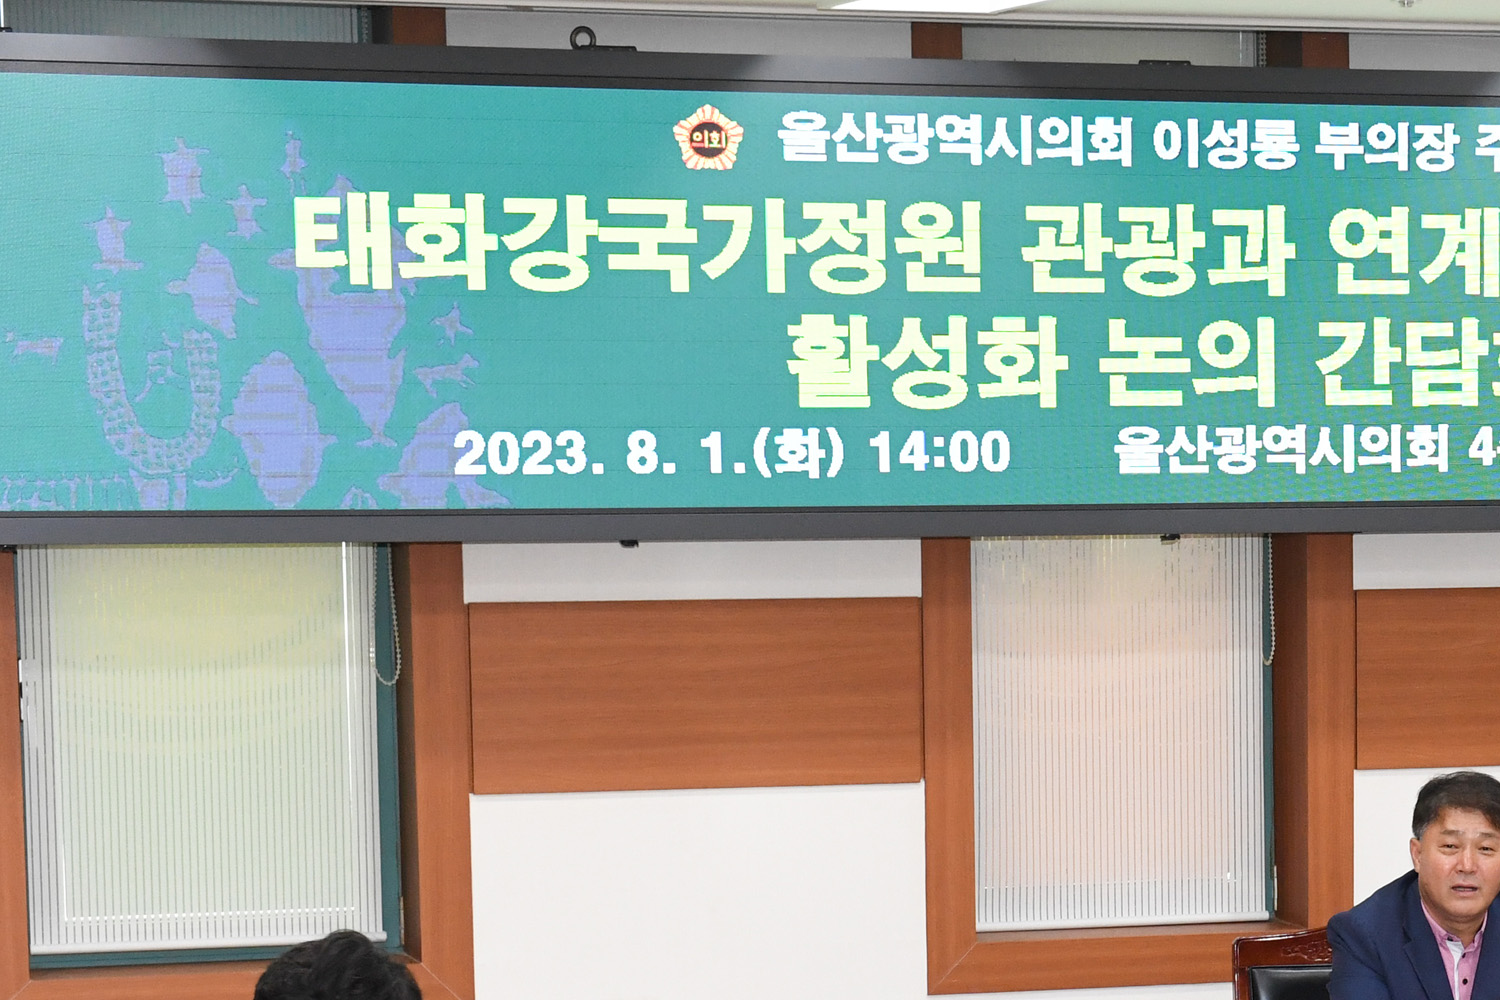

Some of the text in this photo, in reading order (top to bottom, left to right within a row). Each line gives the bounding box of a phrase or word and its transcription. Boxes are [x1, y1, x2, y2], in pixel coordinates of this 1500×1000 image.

[690, 129, 727, 149] 의회
[778, 111, 1133, 167] 울산광역시의회
[1153, 118, 1300, 171] 이성룡
[1315, 121, 1461, 173] 부의장
[294, 191, 982, 295] 태화강국가정원
[1021, 203, 1296, 297] 관광과
[786, 314, 1069, 410] 활성화
[1099, 316, 1276, 408] 논의
[453, 430, 604, 475] 2023.
[626, 430, 676, 475] 8.
[869, 430, 1011, 473] 14:00
[1113, 423, 1451, 475] 울산광역시의회
